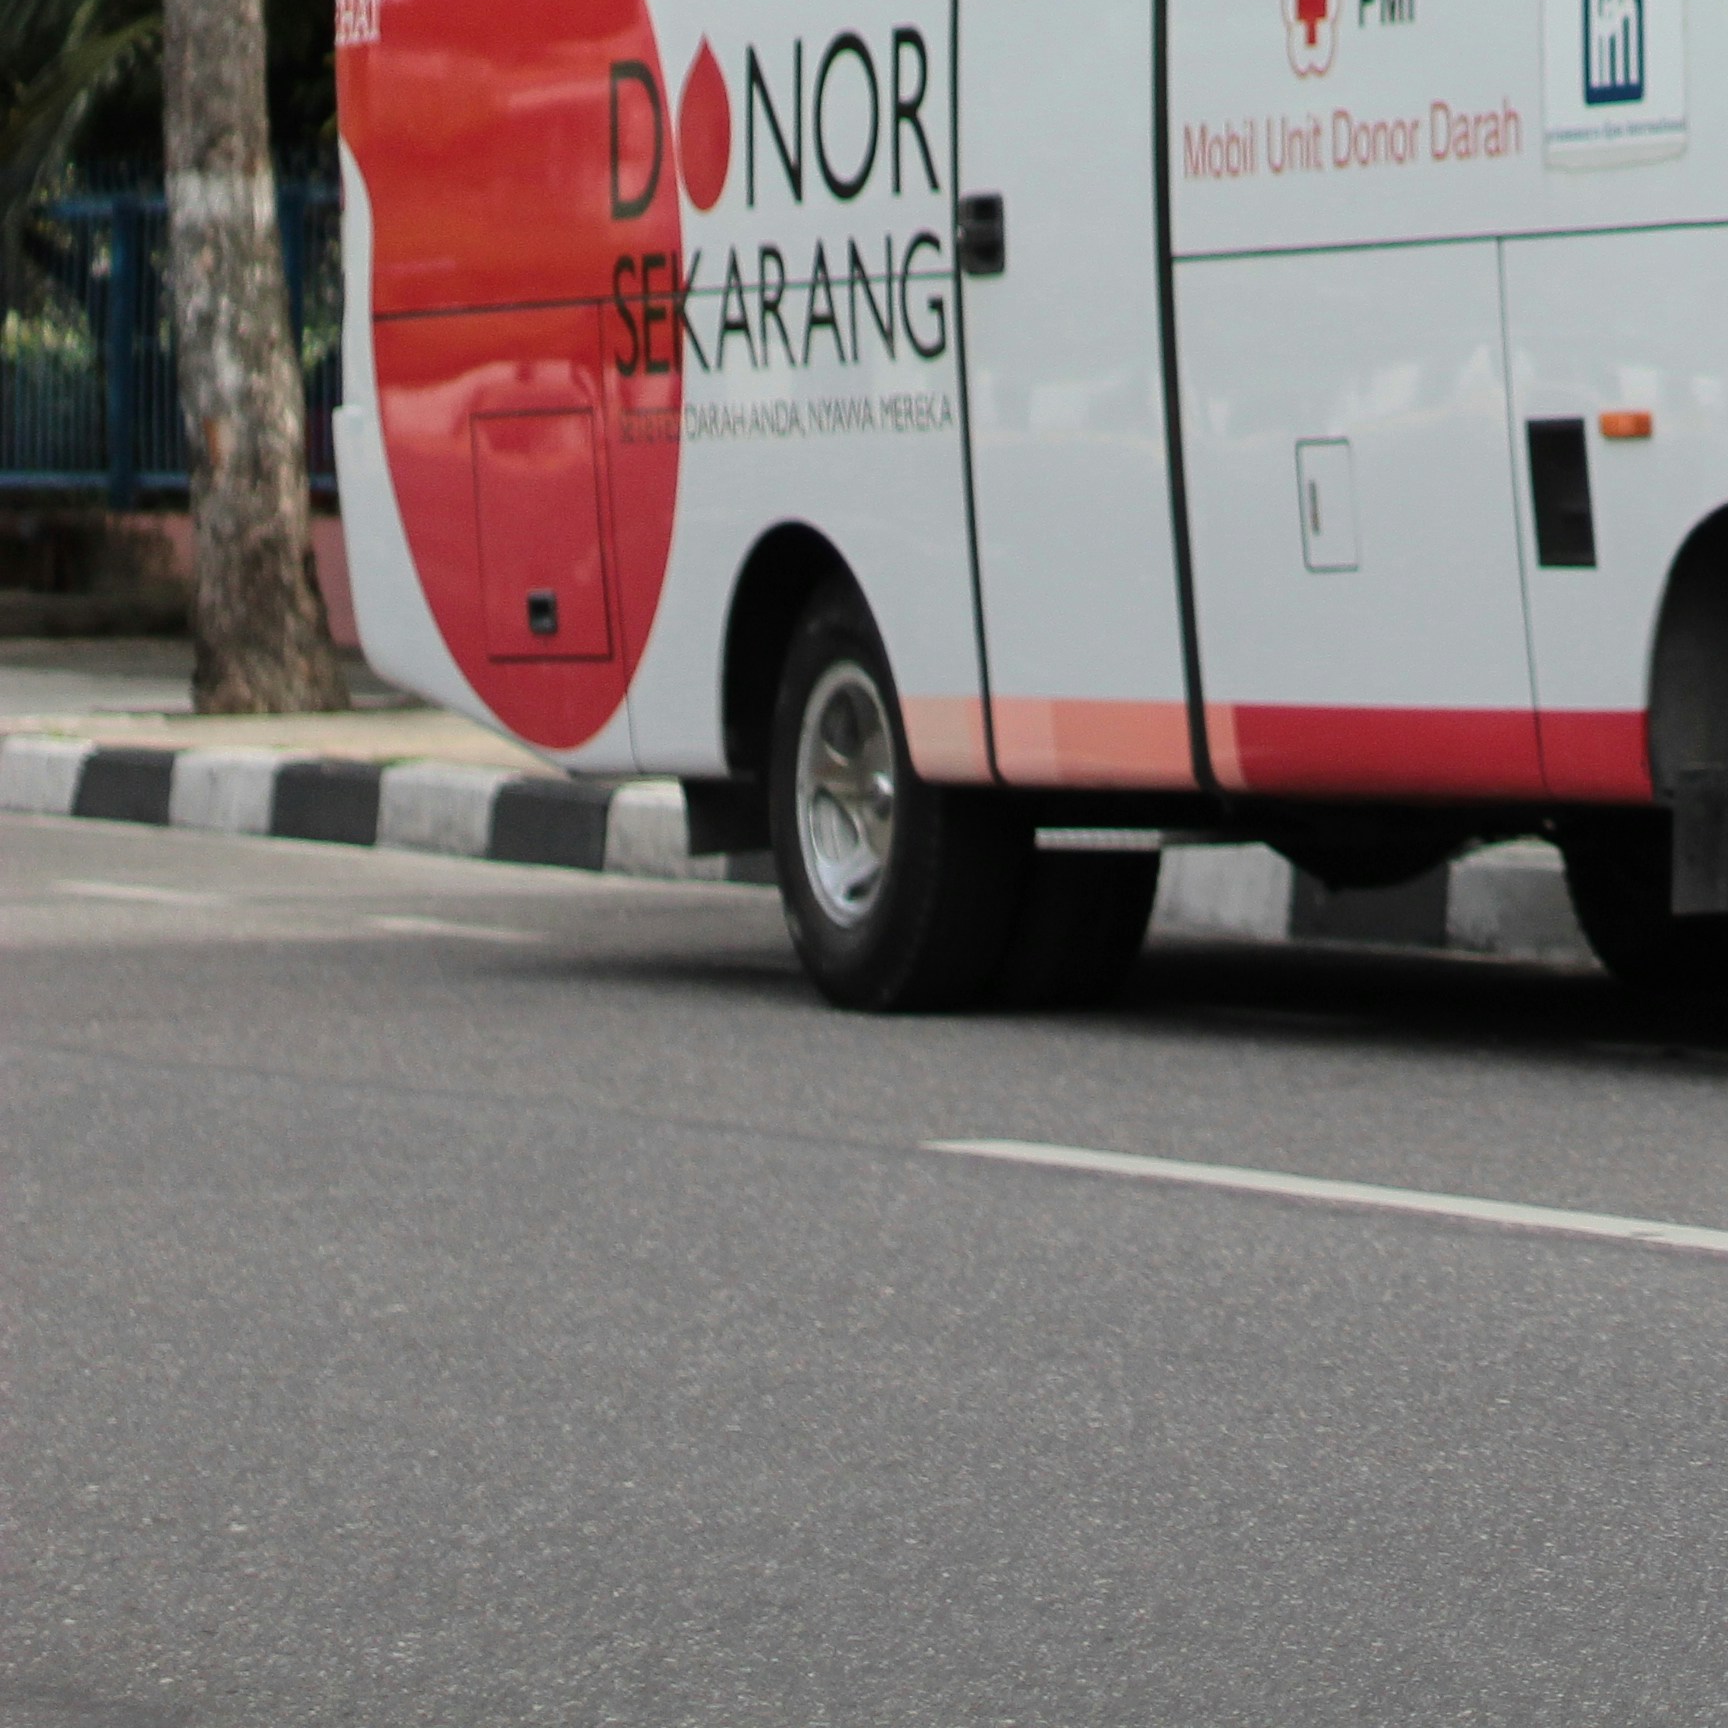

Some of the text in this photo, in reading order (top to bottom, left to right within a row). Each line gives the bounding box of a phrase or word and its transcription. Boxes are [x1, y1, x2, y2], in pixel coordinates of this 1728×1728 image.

[1182, 119, 1255, 178] Mobil
[1266, 112, 1323, 174] Unit
[1331, 108, 1420, 169] Donor
[1430, 98, 1522, 163] Darah
[612, 230, 948, 378] SEKARANG
[685, 400, 745, 442] DARAH
[808, 396, 873, 434] NYAWA
[879, 391, 953, 432] MEREKA
